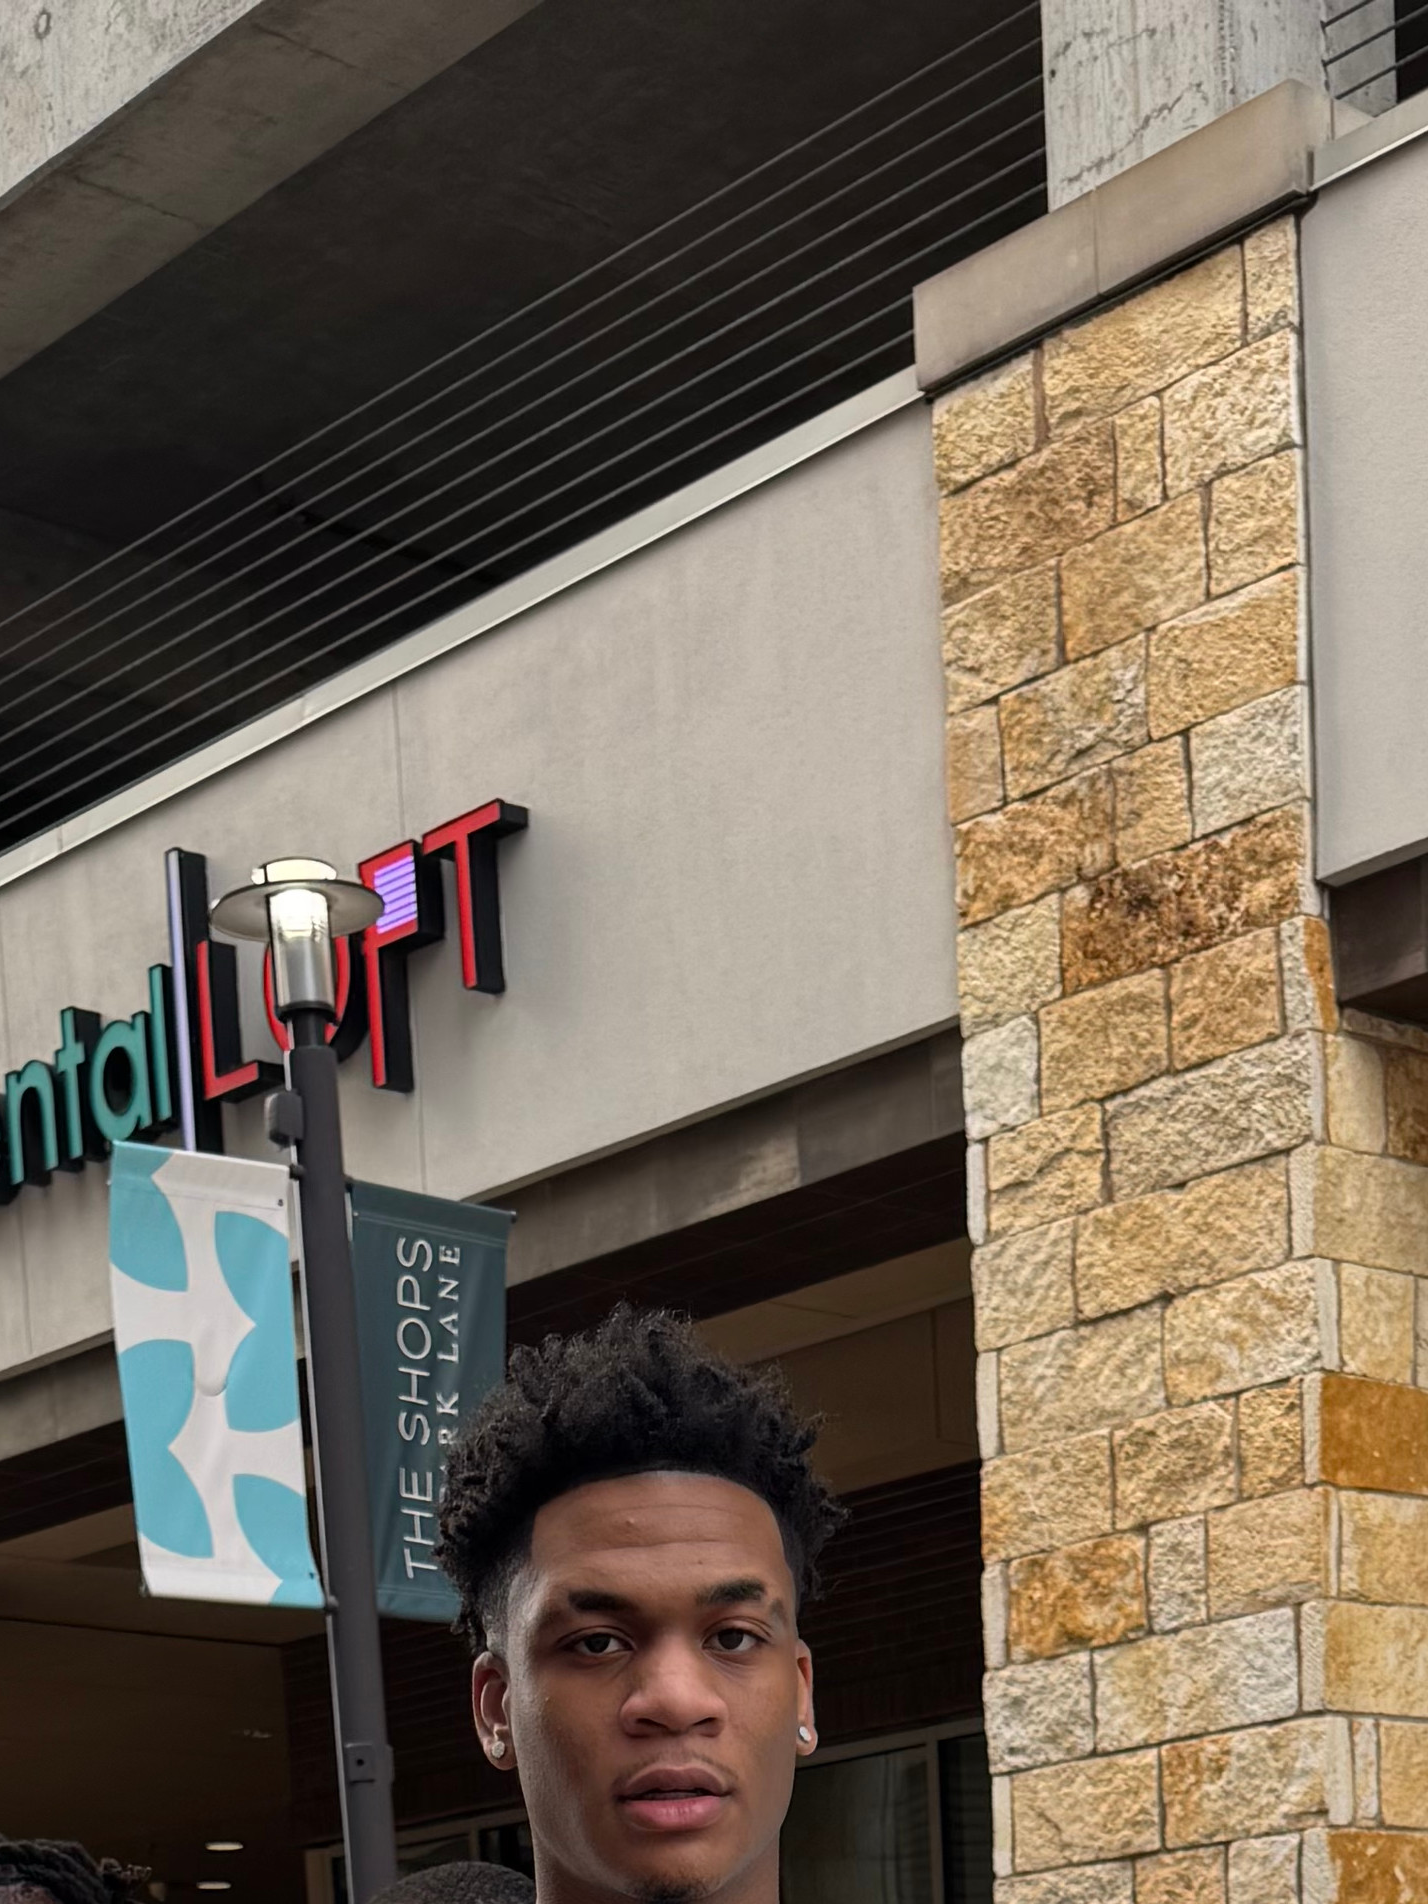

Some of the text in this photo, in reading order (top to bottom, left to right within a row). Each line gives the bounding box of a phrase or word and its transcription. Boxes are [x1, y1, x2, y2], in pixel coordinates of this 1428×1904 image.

[396, 1236, 438, 1580] THE SHOPS
[436, 1245, 461, 1365] LANE
